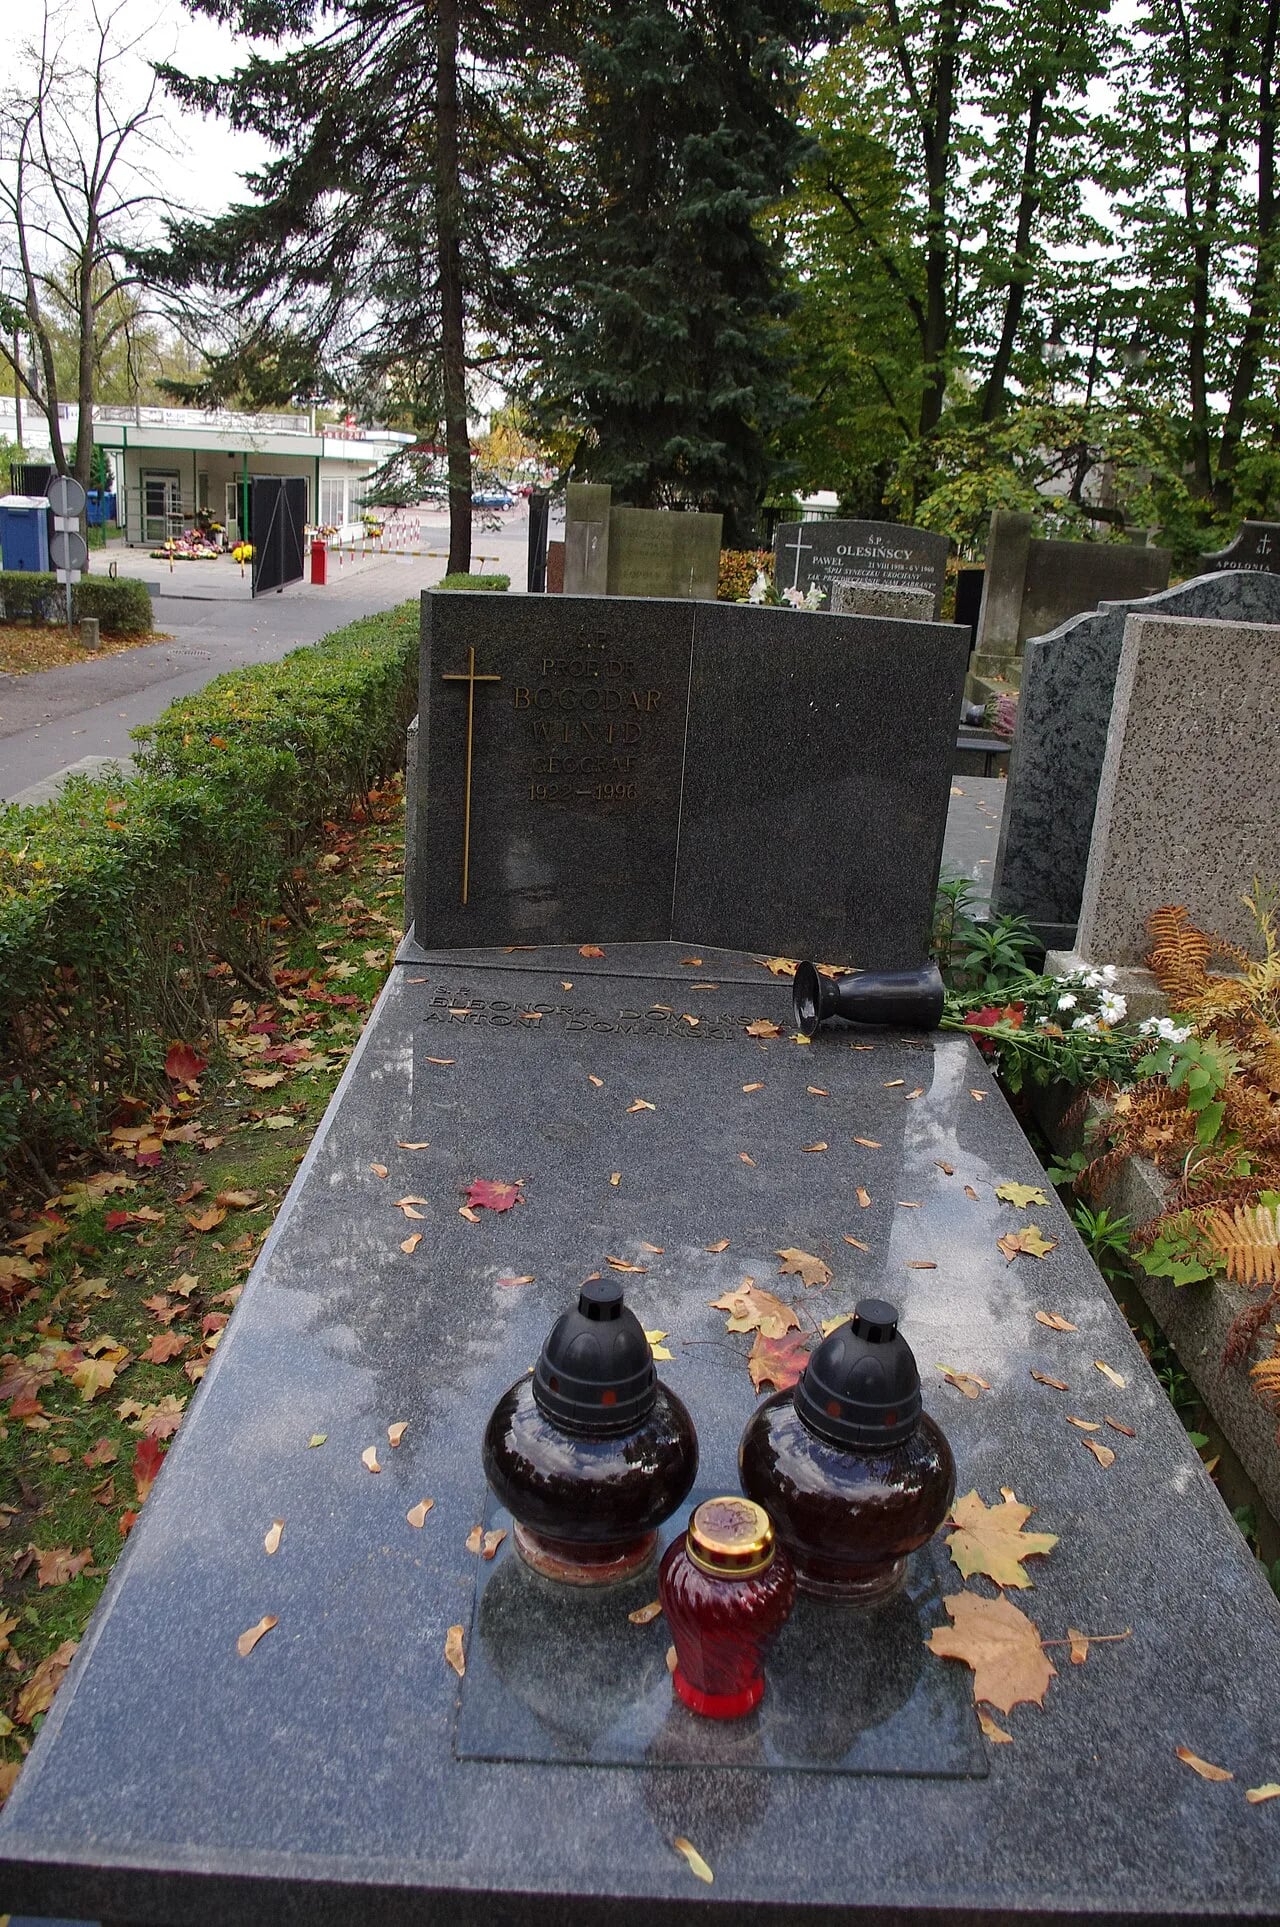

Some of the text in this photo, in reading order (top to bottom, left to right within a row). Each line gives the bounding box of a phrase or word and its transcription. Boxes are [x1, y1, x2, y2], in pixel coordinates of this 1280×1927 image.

[836, 544, 913, 560] OLESIŃSCY
[1216, 561, 1271, 572] APOLONIA
[513, 686, 662, 713] BOGODAR
[532, 719, 641, 745] WINID
[428, 996, 597, 1018] ELEONORA
[422, 1012, 544, 1030] ANTONI
[565, 1018, 735, 1041] DOMAŃSKI
[619, 1008, 794, 1030] DOMAŃSA
